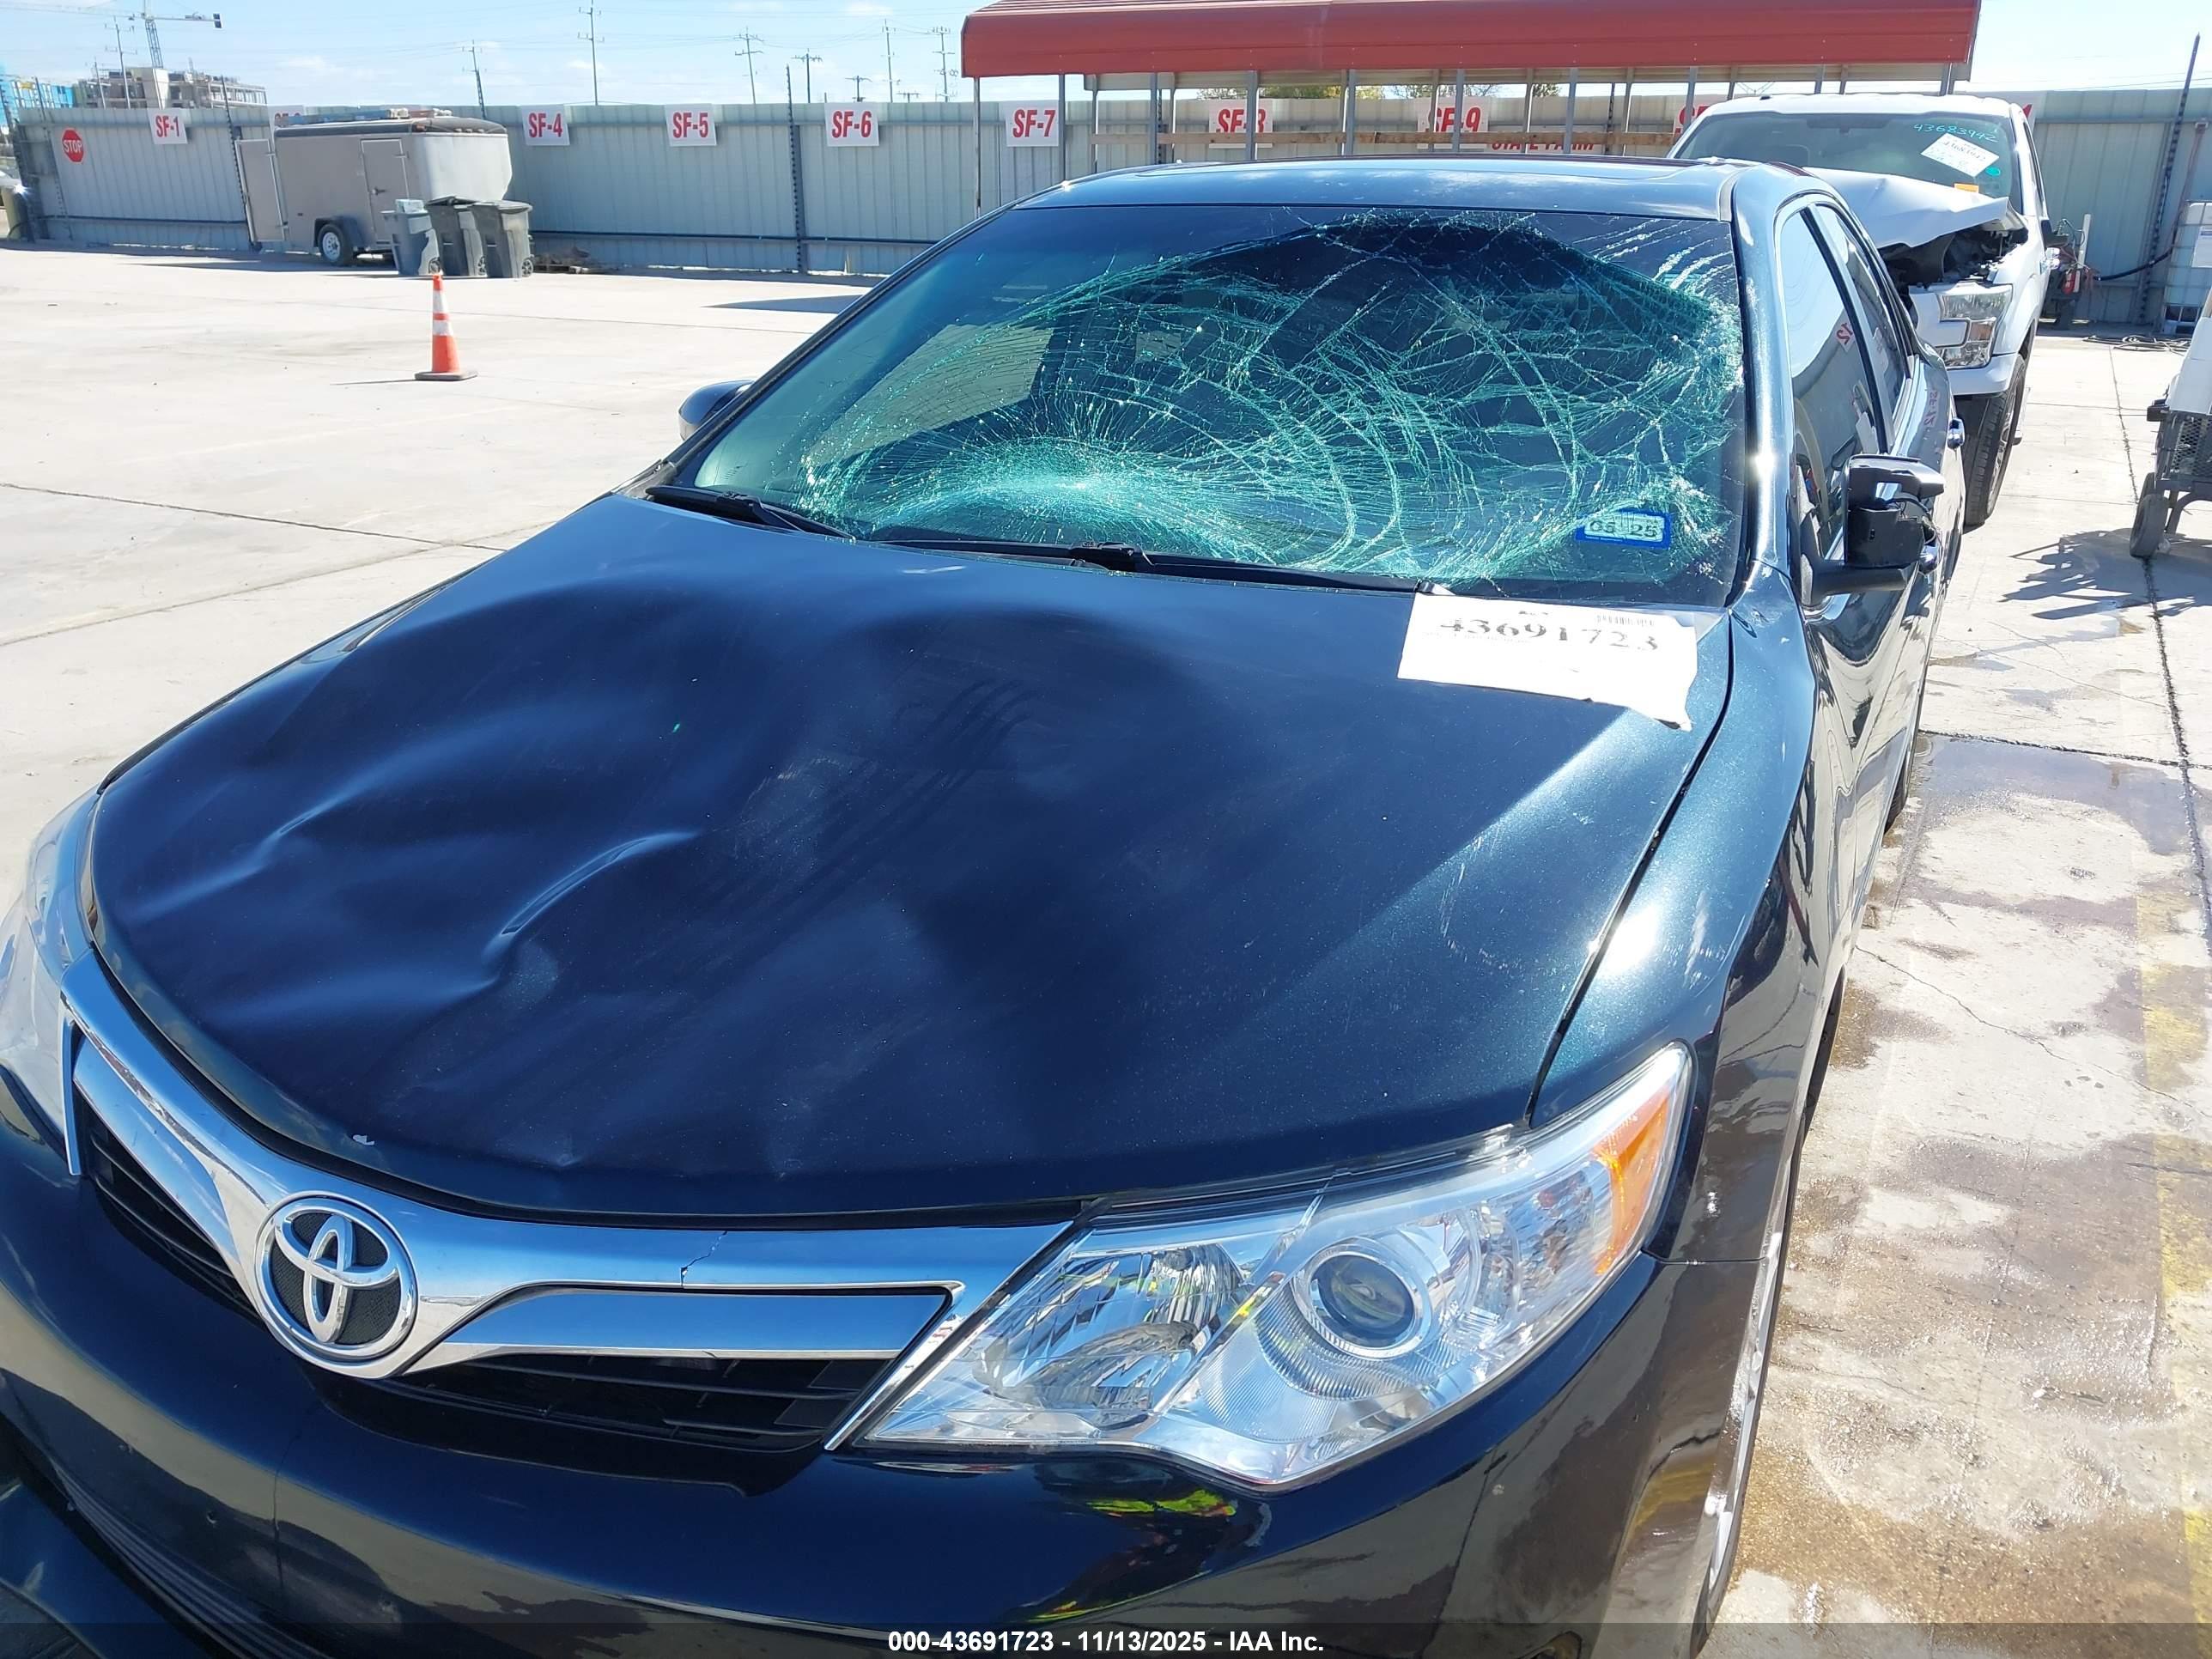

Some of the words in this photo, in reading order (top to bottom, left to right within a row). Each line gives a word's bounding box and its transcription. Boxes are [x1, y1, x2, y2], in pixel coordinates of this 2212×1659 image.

[155, 115, 180, 137] SF-1
[528, 112, 562, 137] SF-4
[672, 112, 708, 138] SF-5
[832, 111, 872, 138] SF-6
[1012, 109, 1056, 138] SF-7
[1913, 124, 1999, 143] 43683942
[63, 139, 82, 153] STOP
[1629, 524, 1658, 538] 25
[1439, 617, 1658, 651] 43691723
